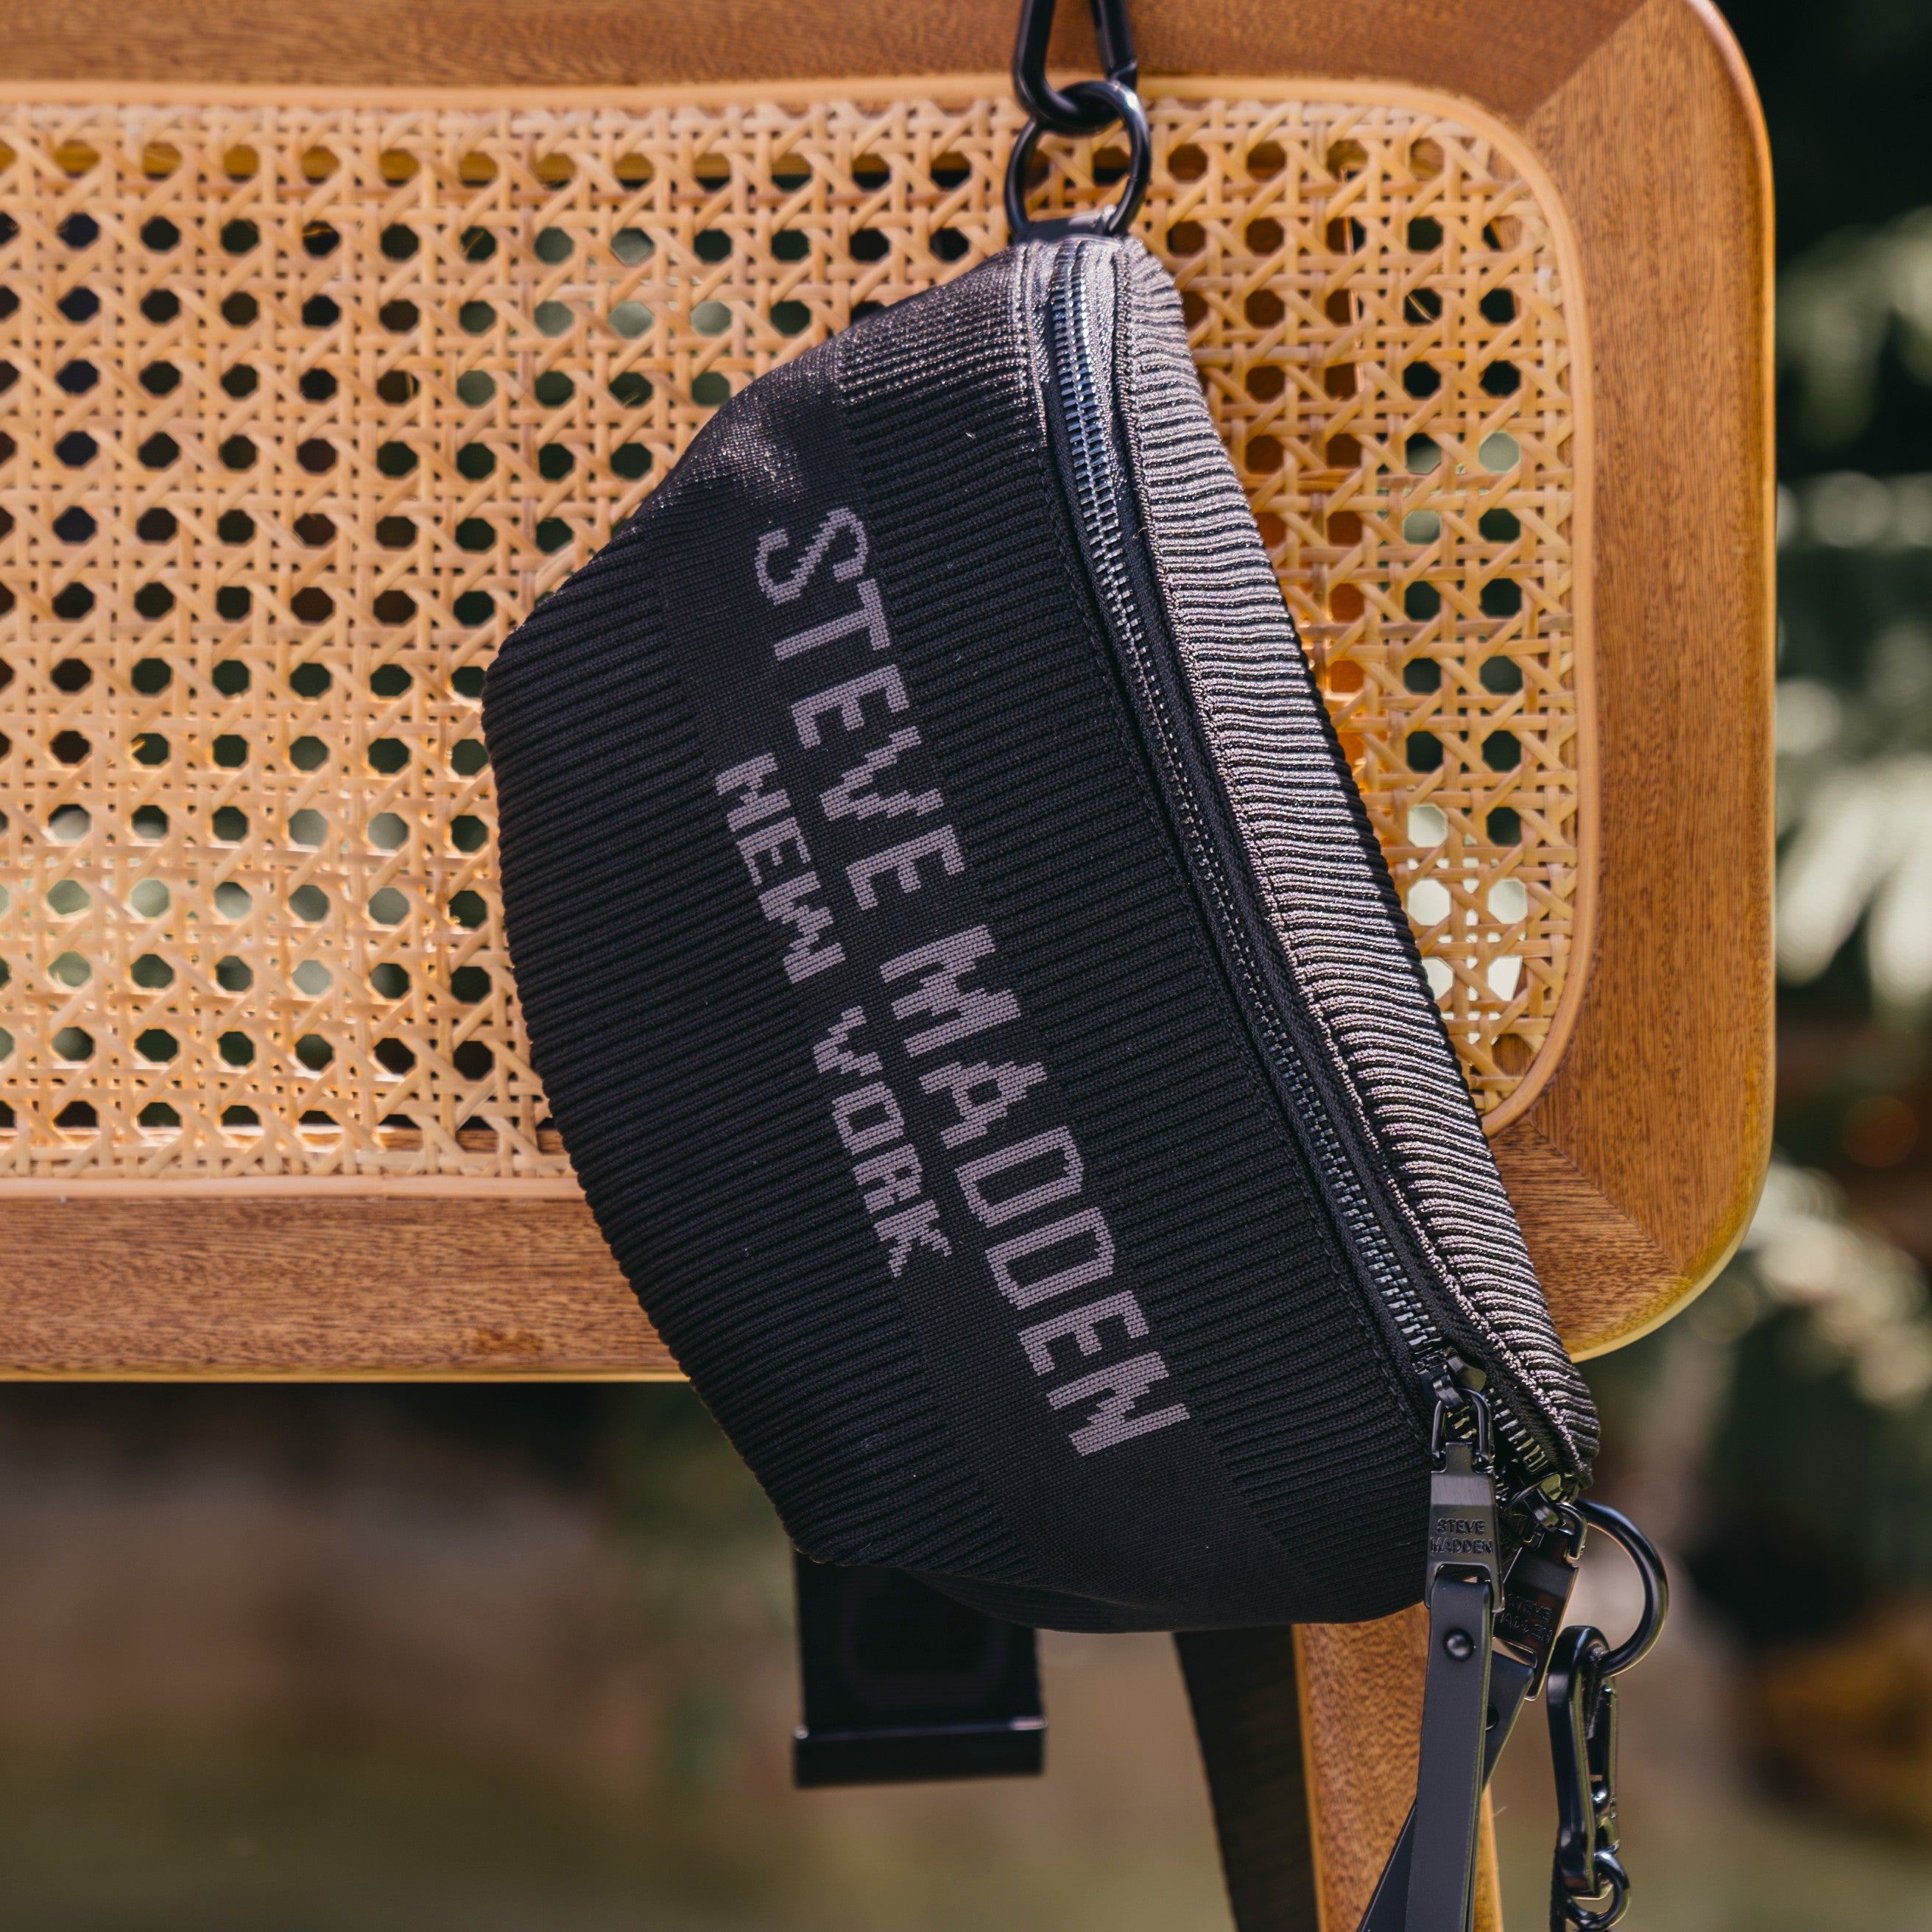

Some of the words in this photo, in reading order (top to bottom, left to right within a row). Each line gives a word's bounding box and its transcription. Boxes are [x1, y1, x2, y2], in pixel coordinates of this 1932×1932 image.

[714, 753, 845, 982] NEW
[813, 1006, 951, 1275] YORK
[755, 508, 964, 909] STEVE
[880, 926, 1188, 1455] MADDEN
[1430, 1537, 1492, 1555] MADDEN
[1436, 1518, 1485, 1534] STEVE
